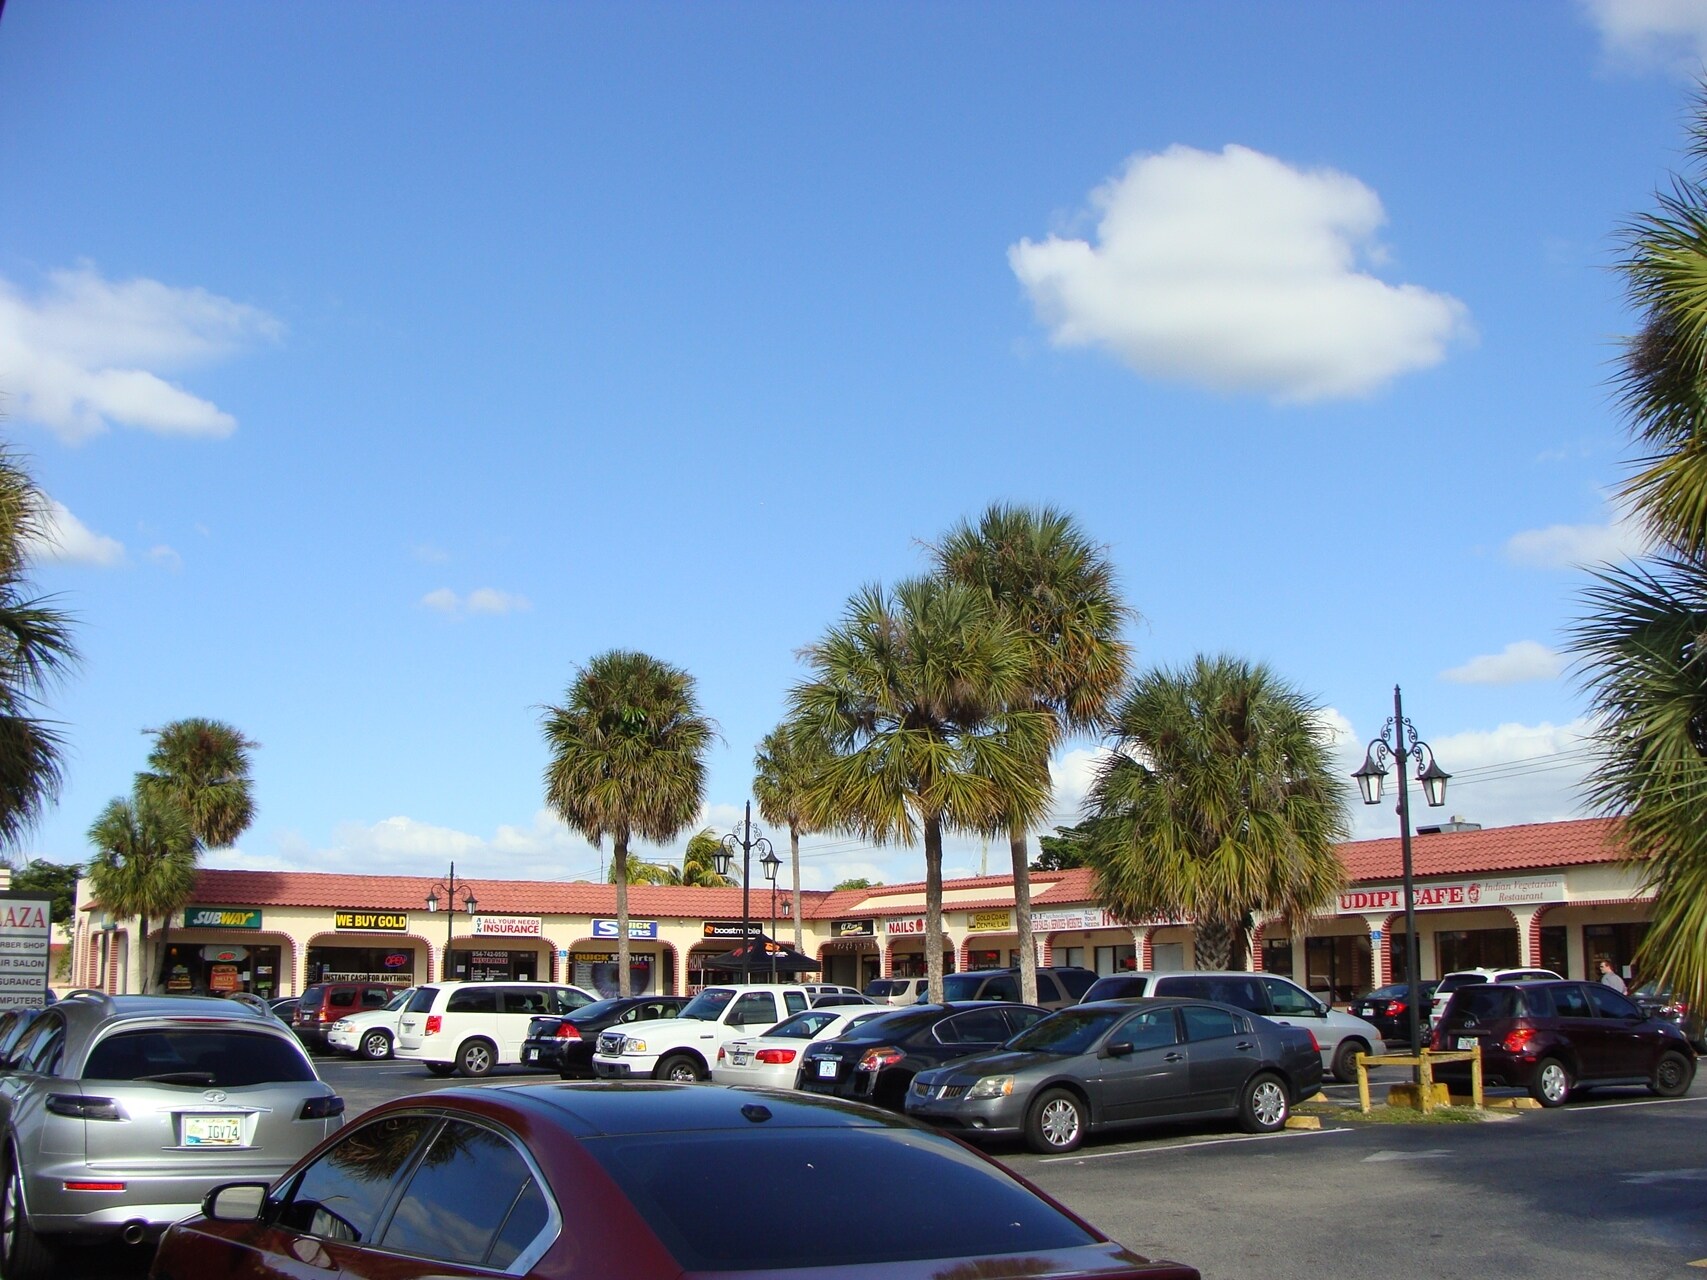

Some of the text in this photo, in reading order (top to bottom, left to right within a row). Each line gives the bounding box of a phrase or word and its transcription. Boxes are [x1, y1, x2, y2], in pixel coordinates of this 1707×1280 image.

[1485, 879, 1558, 892] Indian Vegetarian
[1340, 886, 1463, 909] UDIPI CAFE
[1498, 892, 1543, 902] Restaurant
[0, 906, 46, 928] AZA
[193, 911, 254, 925] SUBWAY
[336, 914, 406, 928] WE BUY GOLD
[483, 924, 539, 933] INSURANCE
[889, 921, 914, 934] NAILS
[386, 956, 406, 965] OPEN
[575, 953, 609, 961] QUICK
[13, 960, 45, 968] SALON
[323, 973, 349, 981] INSTANT
[381, 974, 411, 982] ANYTHING
